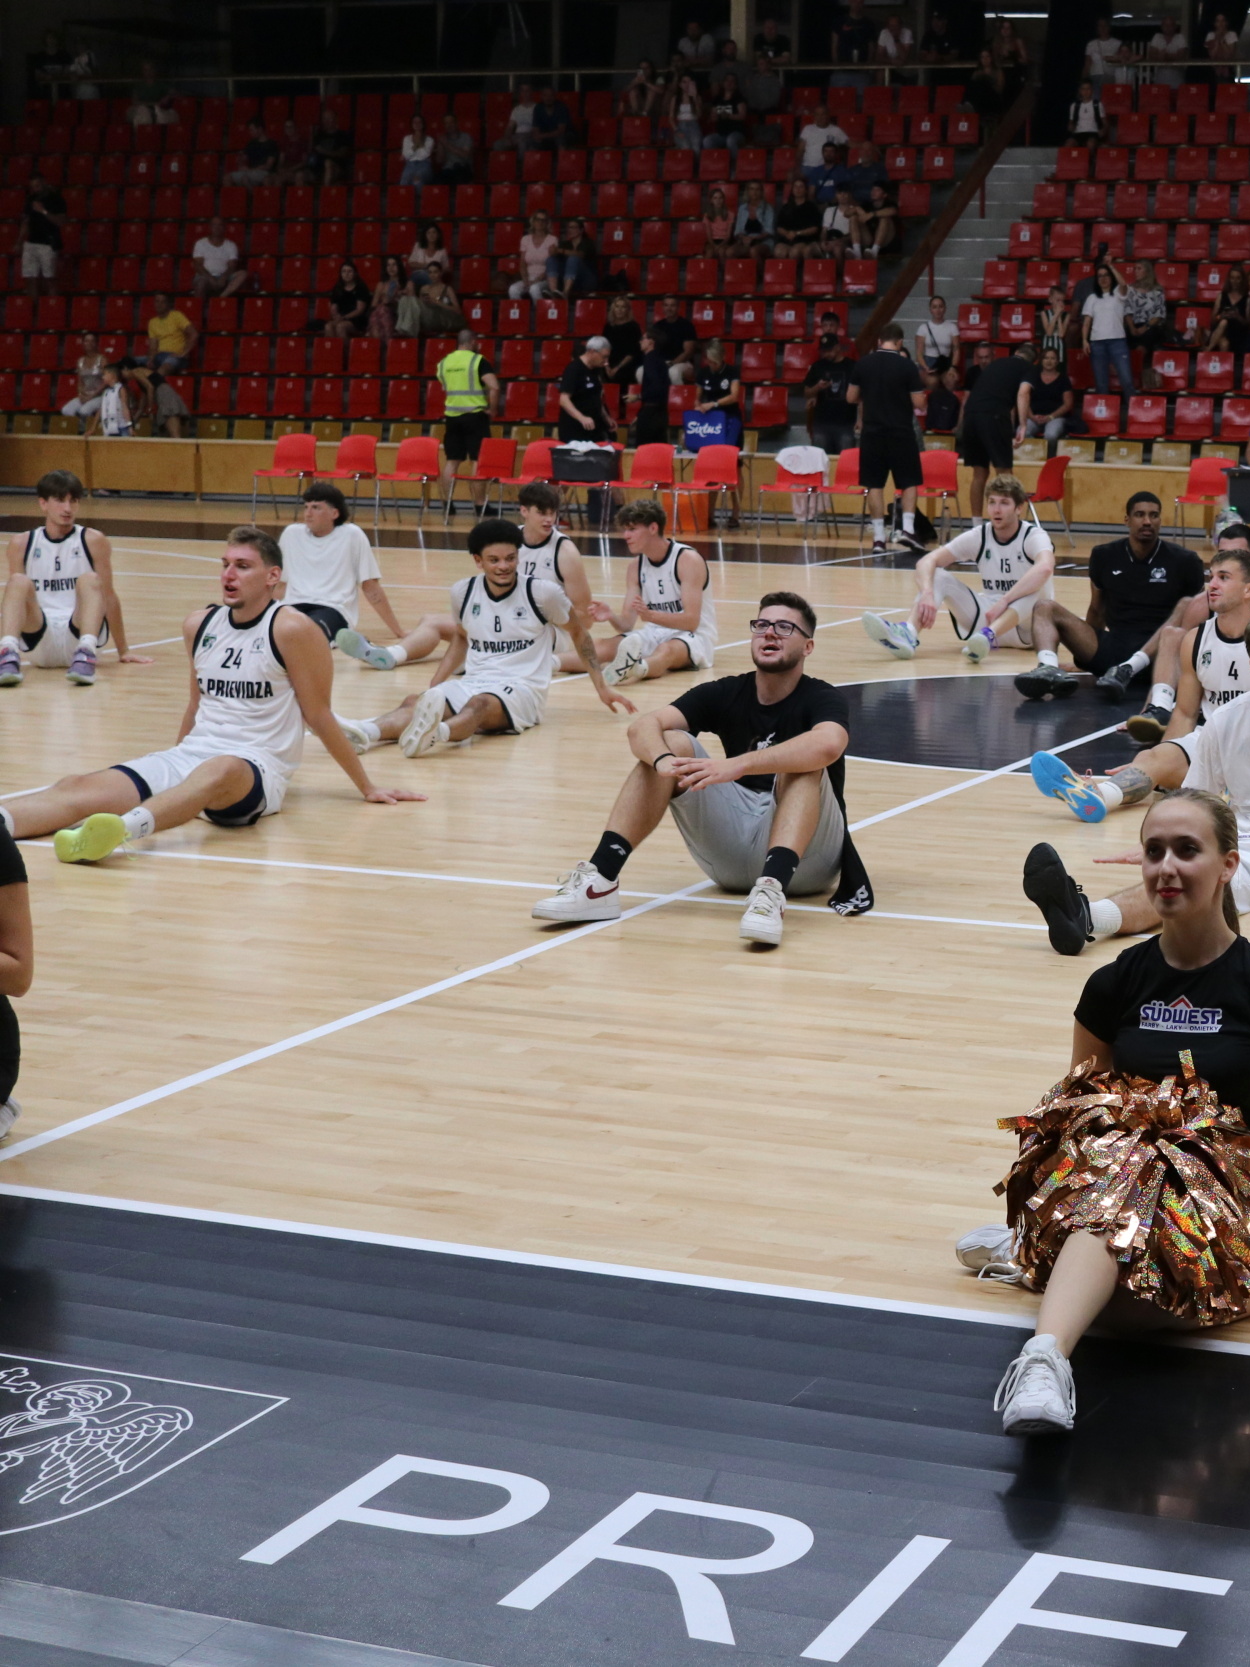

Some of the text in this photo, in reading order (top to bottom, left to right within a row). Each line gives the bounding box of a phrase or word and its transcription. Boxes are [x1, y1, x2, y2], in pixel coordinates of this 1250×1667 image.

[686, 421, 722, 438] Sixtus
[55, 556, 61, 571] 6
[525, 561, 536, 577] 12
[1000, 558, 1011, 573] 15
[658, 579, 664, 595] 5
[494, 616, 502, 633] 8
[221, 647, 243, 669] 24
[1228, 661, 1238, 680] 4
[207, 678, 273, 699] PRIEVIDZA
[1141, 1001, 1220, 1024] SÜDWEST
[1141, 1021, 1159, 1029] FARBY
